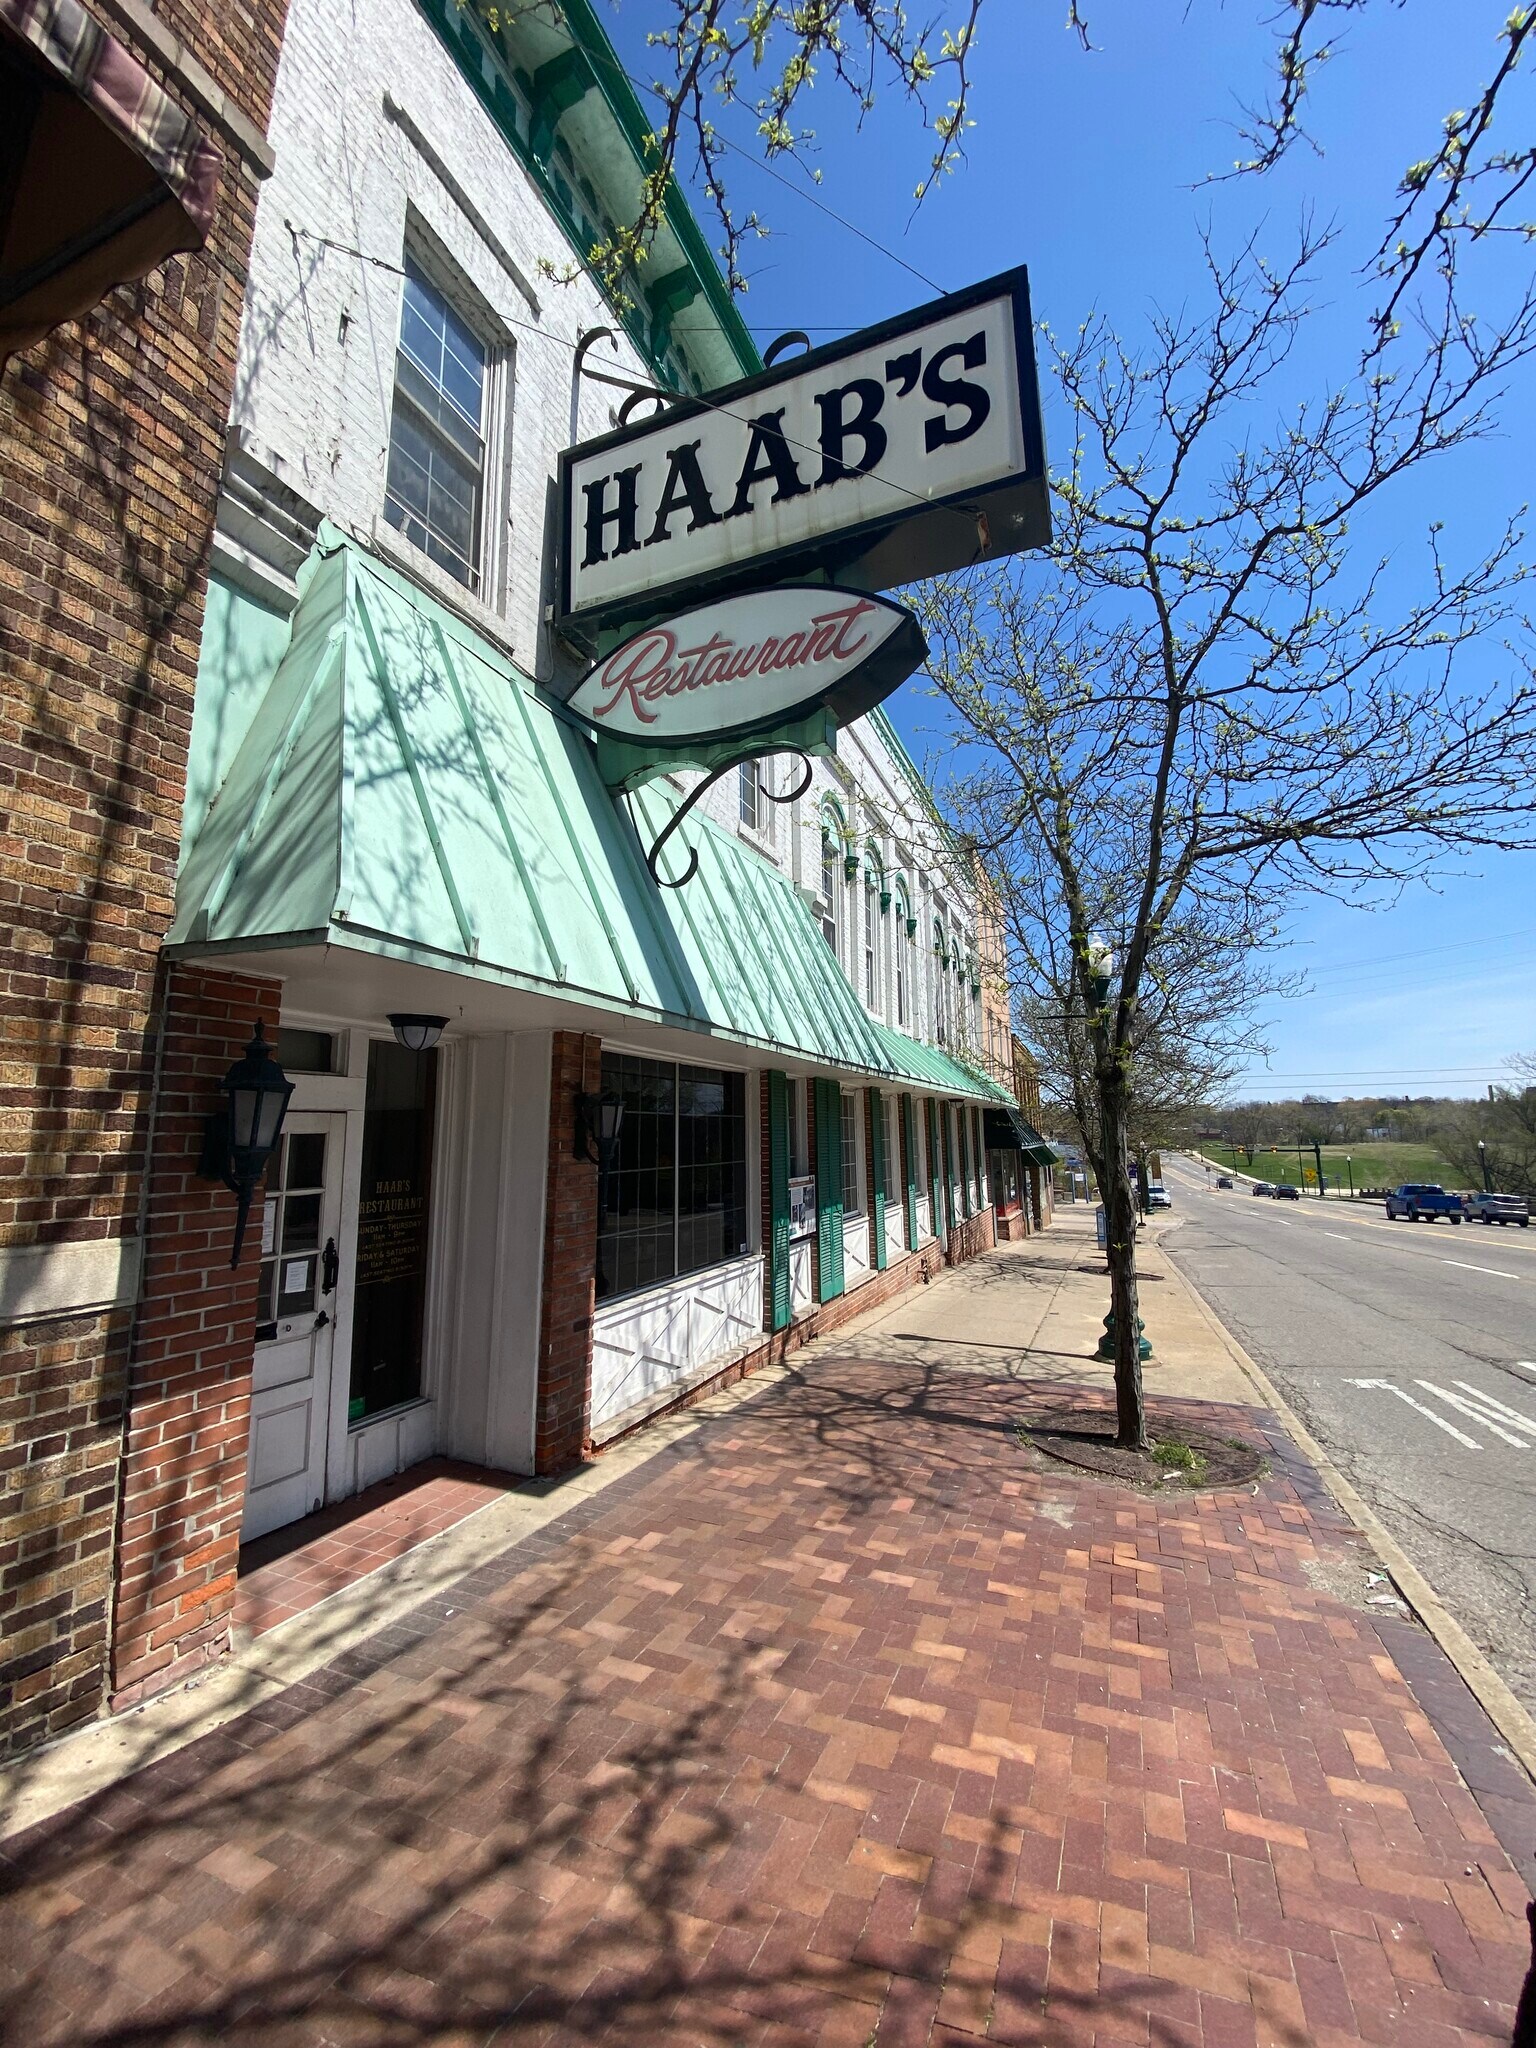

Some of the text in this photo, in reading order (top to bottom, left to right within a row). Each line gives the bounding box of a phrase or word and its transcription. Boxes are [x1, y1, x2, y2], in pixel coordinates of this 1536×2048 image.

[580, 330, 991, 571] HAAB'S
[592, 598, 878, 724] Restaurant
[359, 1197, 424, 1214] RESTAURANT
[376, 1179, 411, 1194] HAAB'S
